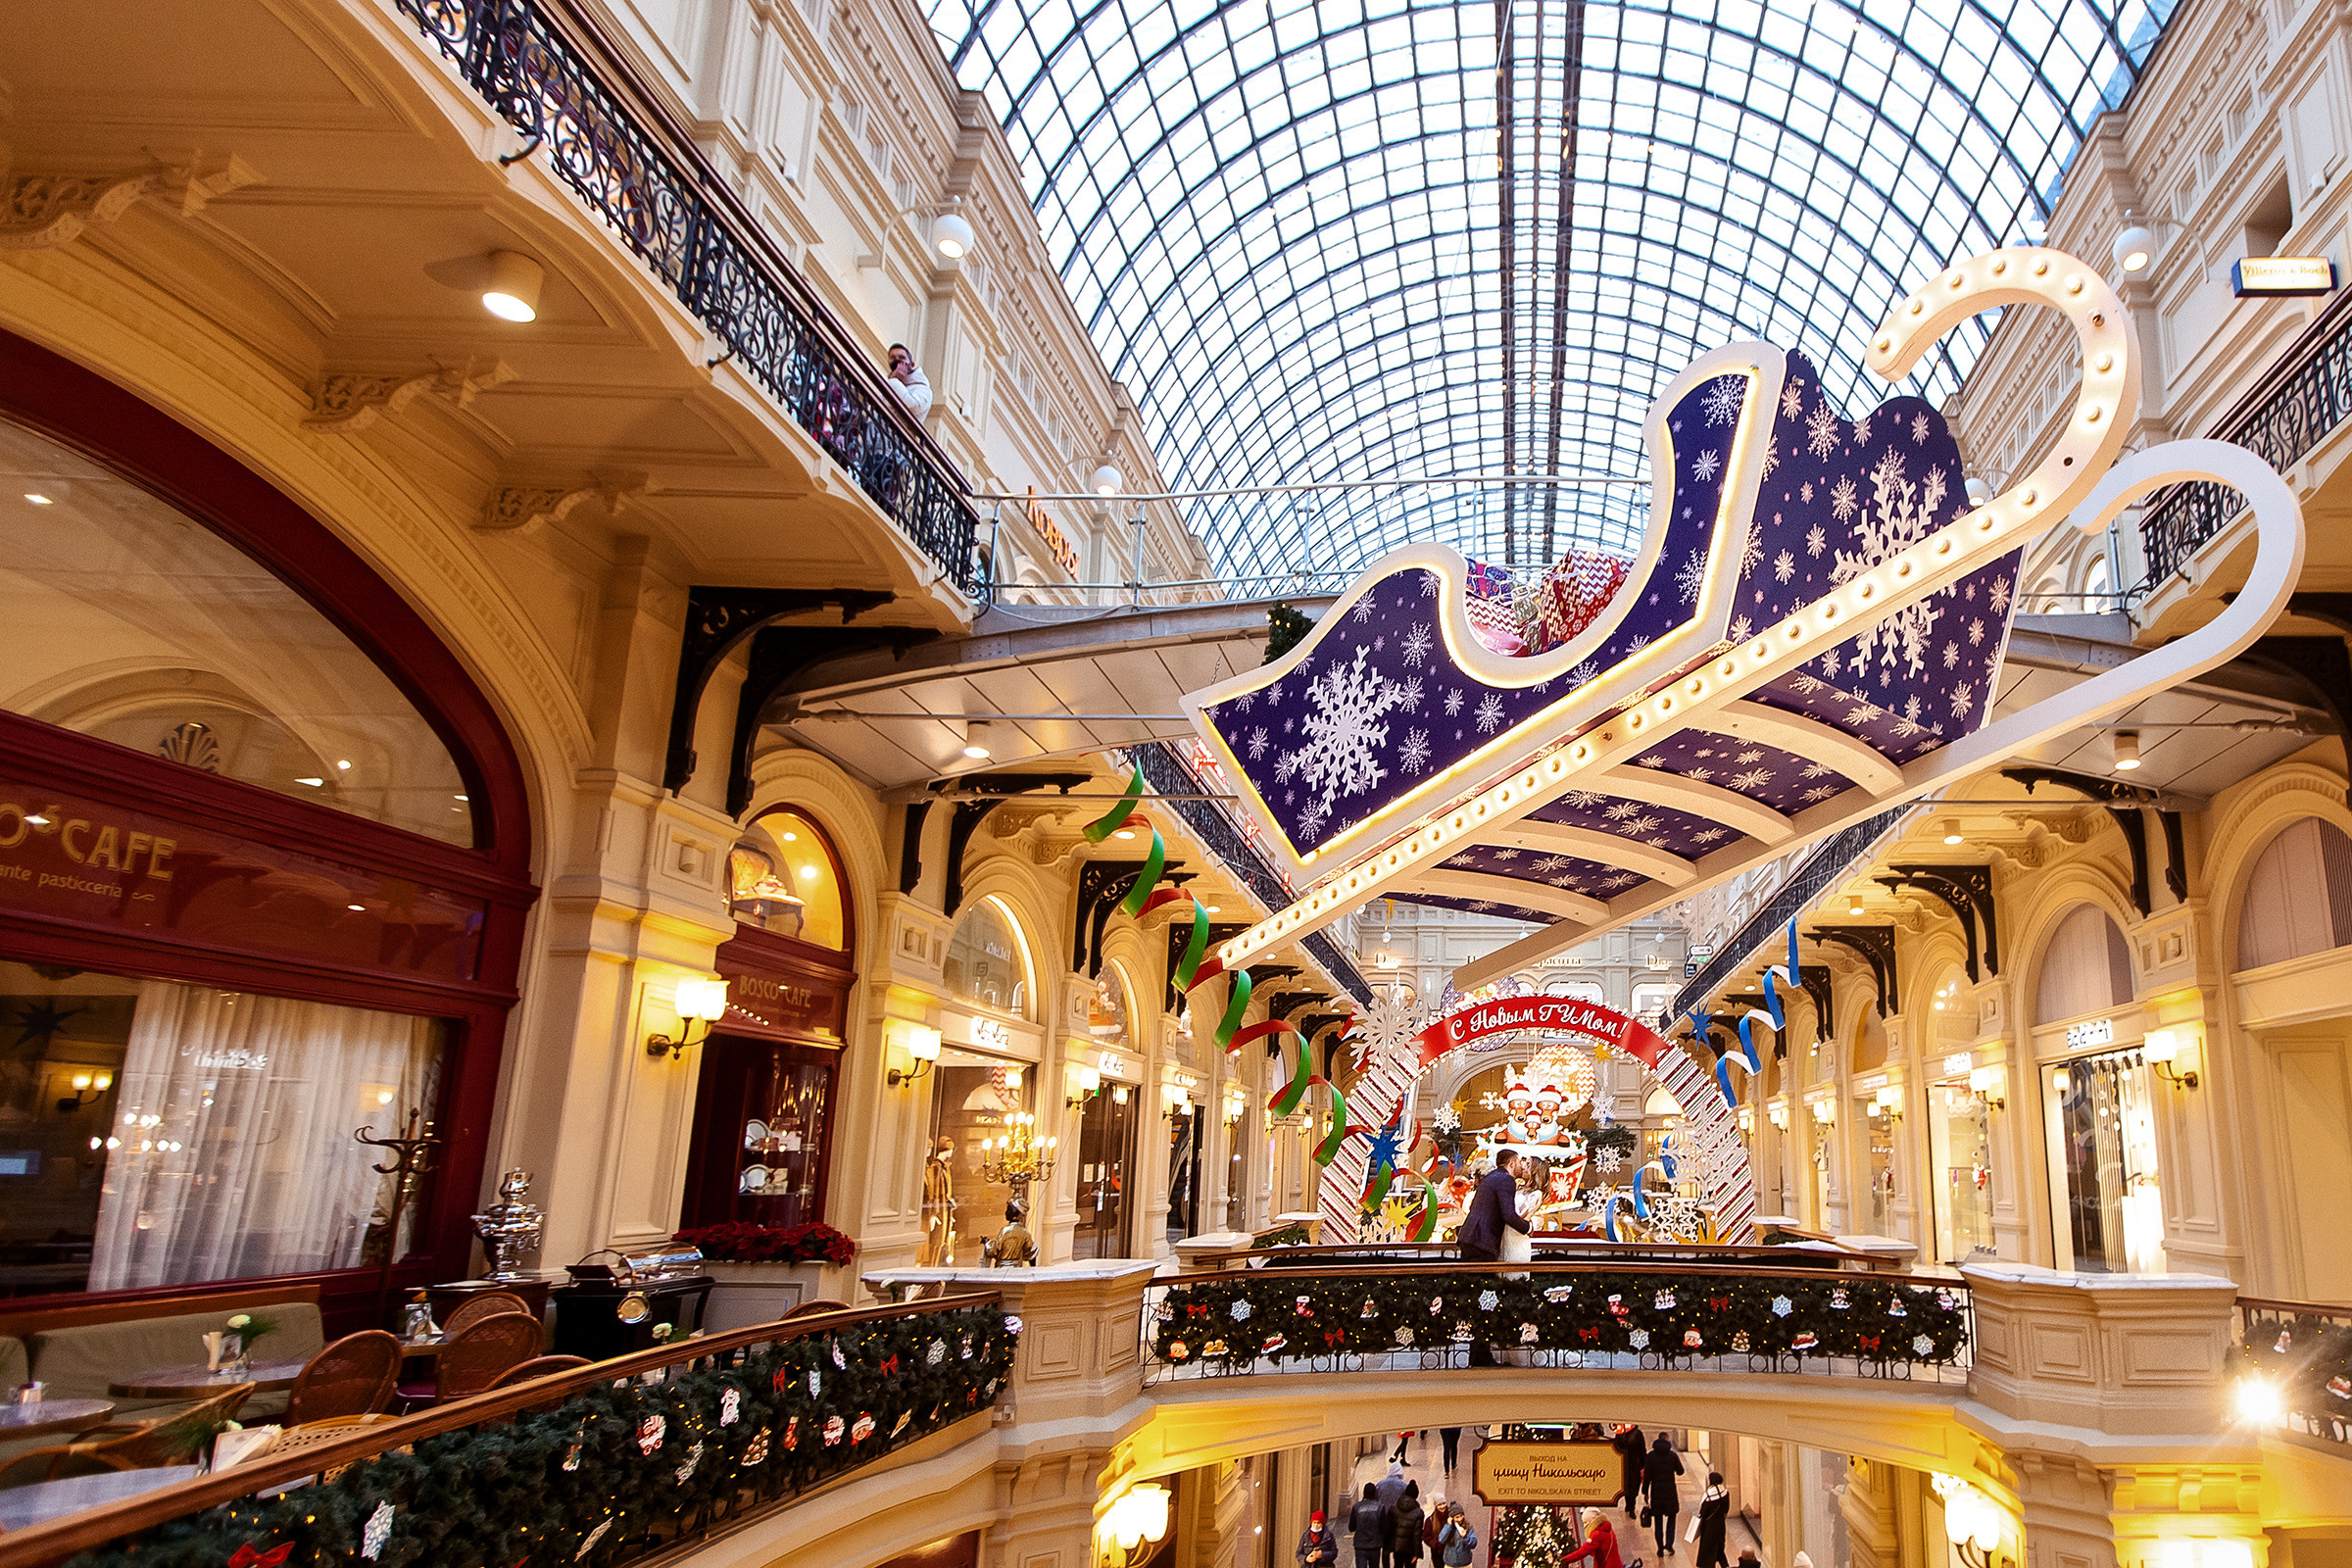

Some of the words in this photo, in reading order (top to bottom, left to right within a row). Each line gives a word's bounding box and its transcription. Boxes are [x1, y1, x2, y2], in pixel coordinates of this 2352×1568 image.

[61, 818, 176, 882] CAFE
[37, 872, 122, 898] pasticceria
[739, 974, 779, 1001] BOSCO
[1450, 1019, 1466, 1041] С
[1469, 1005, 1537, 1033] Новым
[1529, 1454, 1556, 1463] ВЫХОД
[1493, 1468, 1529, 1482] улицу
[1533, 1463, 1607, 1483] Никольскую
[1527, 1488, 1573, 1496] NIKOLSKAYA
